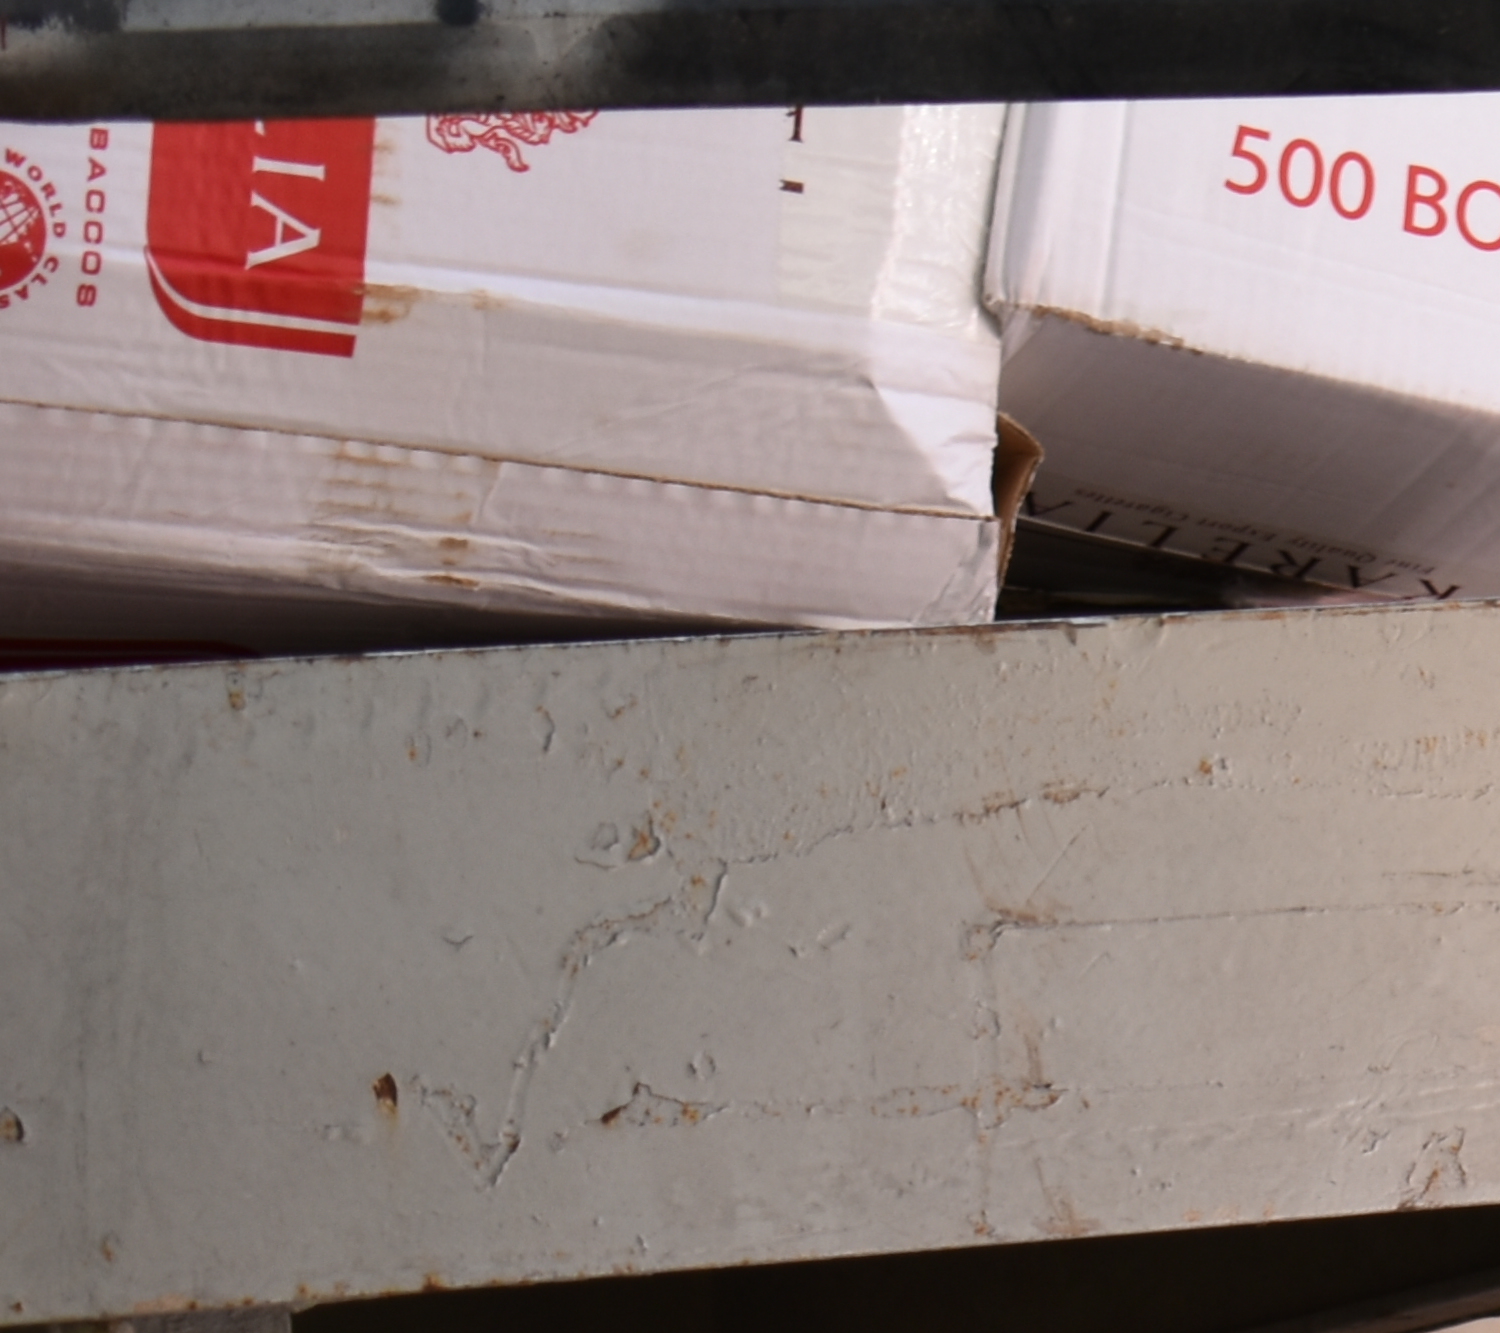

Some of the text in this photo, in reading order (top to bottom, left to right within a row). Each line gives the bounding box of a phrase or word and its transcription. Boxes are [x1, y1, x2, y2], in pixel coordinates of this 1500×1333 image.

[4, 147, 66, 240] WORLD
[245, 120, 326, 270] IA
[1223, 124, 1375, 220] 500
